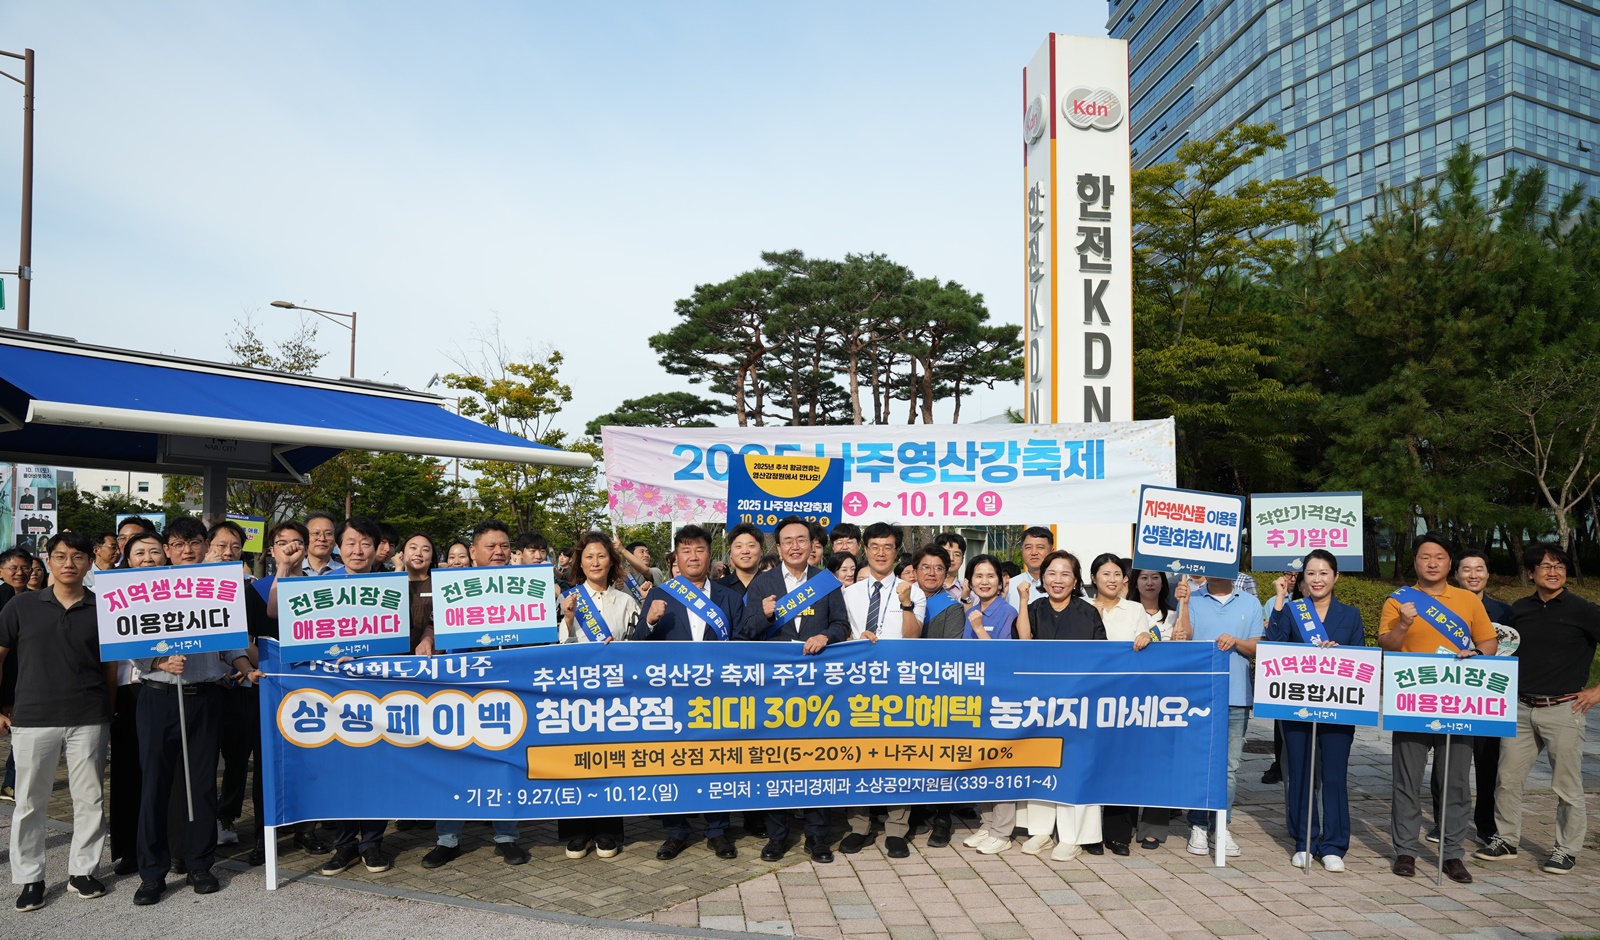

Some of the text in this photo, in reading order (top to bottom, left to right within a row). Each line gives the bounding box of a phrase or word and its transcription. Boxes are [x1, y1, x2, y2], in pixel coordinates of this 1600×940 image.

[1026, 112, 1039, 131] Kdn
[1073, 100, 1108, 117] Kdn
[1075, 172, 1115, 423] 한전KDN
[204, 443, 221, 452] NAJU
[673, 439, 1106, 485] 20 나주영산강축제
[753, 462, 821, 472] 2025년 추석 황금연휴는
[752, 472, 798, 481] 영산강정원에서
[737, 499, 833, 514] 2025 나주영산강축제
[1144, 500, 1238, 527] 지역생산품 이용을
[1256, 504, 1357, 528] 착한가격업소
[1142, 523, 1235, 553] 생활화합시다.
[1266, 527, 1349, 549] 추가할인
[1186, 563, 1206, 574] 나주시
[103, 577, 238, 613] 지역생산품을
[288, 585, 402, 617] 전통시장을
[440, 575, 547, 604] 전통시장을
[776, 586, 816, 617] 지역경제
[116, 607, 231, 636] 이용합시다
[292, 613, 401, 642] 애용합시다
[445, 602, 547, 628] 애용합시다
[174, 640, 202, 650] 나주시
[344, 643, 370, 654] 나주시
[495, 633, 519, 643] 나주시
[445, 655, 494, 678] 나주
[532, 664, 625, 693] 추석명절
[645, 662, 714, 688] 영산강
[720, 662, 766, 688] 축제
[772, 662, 818, 687] 주간
[823, 660, 891, 685] 풍성한
[896, 660, 986, 686] 할인혜택
[1261, 655, 1377, 684] 지역생산품을
[1393, 665, 1510, 695] 전통시장을
[1269, 681, 1365, 706] 이용합시다
[1395, 692, 1508, 718] 애용합시다
[291, 699, 511, 742] 상생페이백
[535, 693, 1211, 735] 참여상점, 최대 30% 할인혜택 놓치지 마세요~
[1313, 710, 1337, 720] 나주시
[1446, 722, 1472, 732] 나주시
[573, 750, 627, 770] 페이백
[631, 748, 666, 768] 참여
[670, 747, 704, 767] 상점
[709, 746, 744, 765] 자체
[748, 745, 863, 765] 할인(5~20%)
[884, 744, 935, 763] 나주시
[939, 744, 973, 763] 지원
[978, 746, 1014, 761] 10%
[517, 786, 582, 806] 9.27.(토)
[604, 783, 679, 804] 10.12.(일)
[708, 780, 752, 800] 문의처
[766, 777, 852, 797] 일자리경제과
[855, 773, 1058, 794] 소상공인지원팀(339-8161~4)
